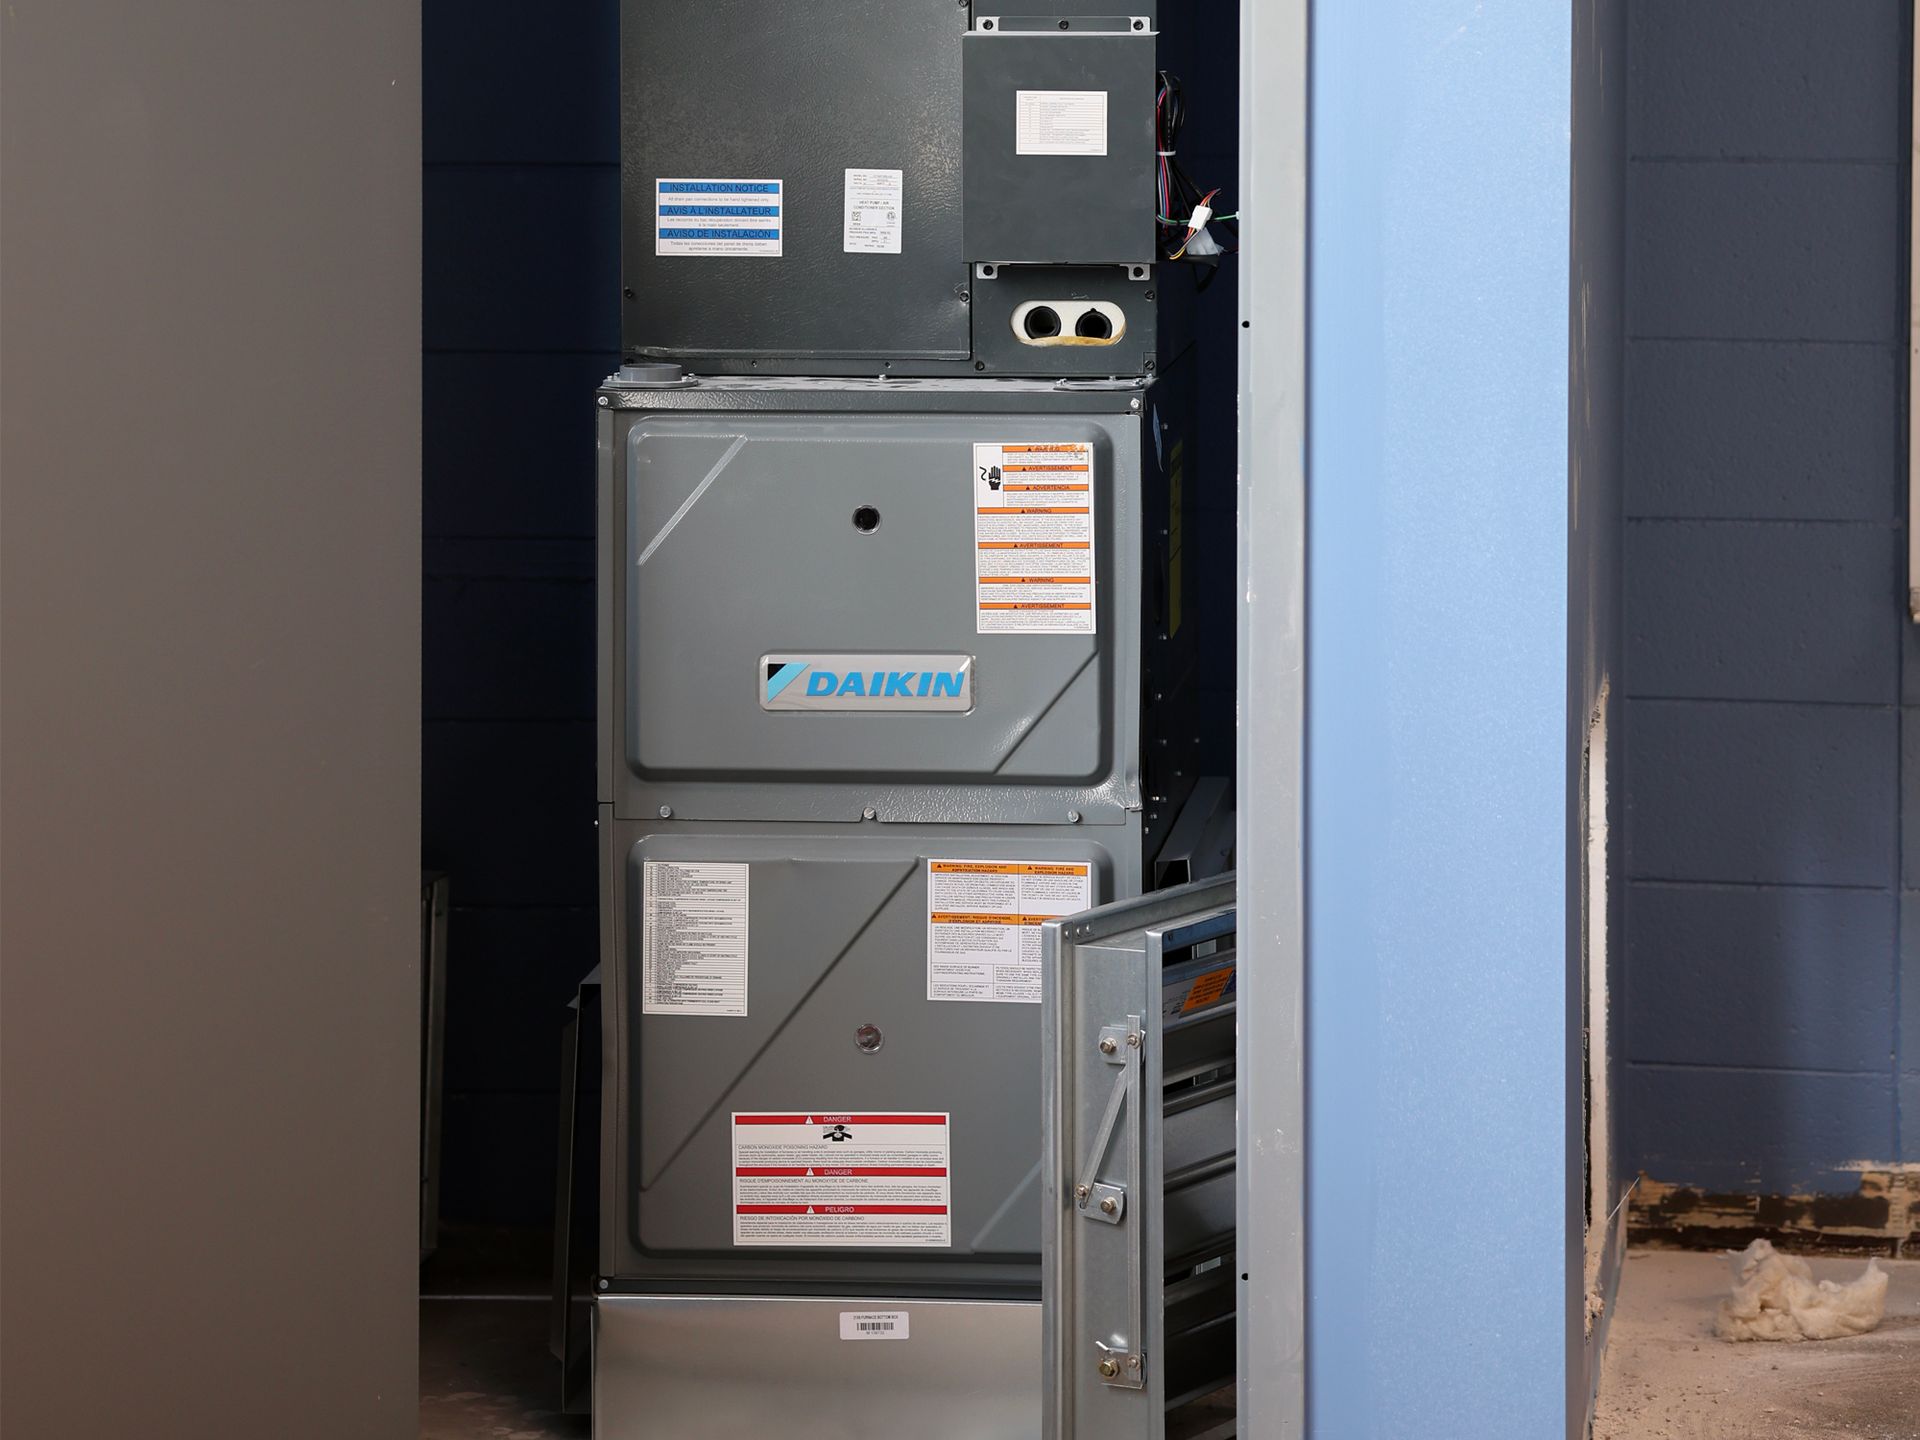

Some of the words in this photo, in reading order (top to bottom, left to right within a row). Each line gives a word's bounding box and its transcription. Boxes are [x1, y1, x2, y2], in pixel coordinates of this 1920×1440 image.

[670, 184, 732, 192] INSTALLATION
[736, 184, 768, 192] NOTICE
[667, 207, 688, 215] AVIS
[690, 206, 696, 215] À
[699, 207, 771, 215] L'INSTALLATEUR
[712, 229, 771, 238] INSTALACIÓN
[806, 672, 964, 697] DAIKIN
